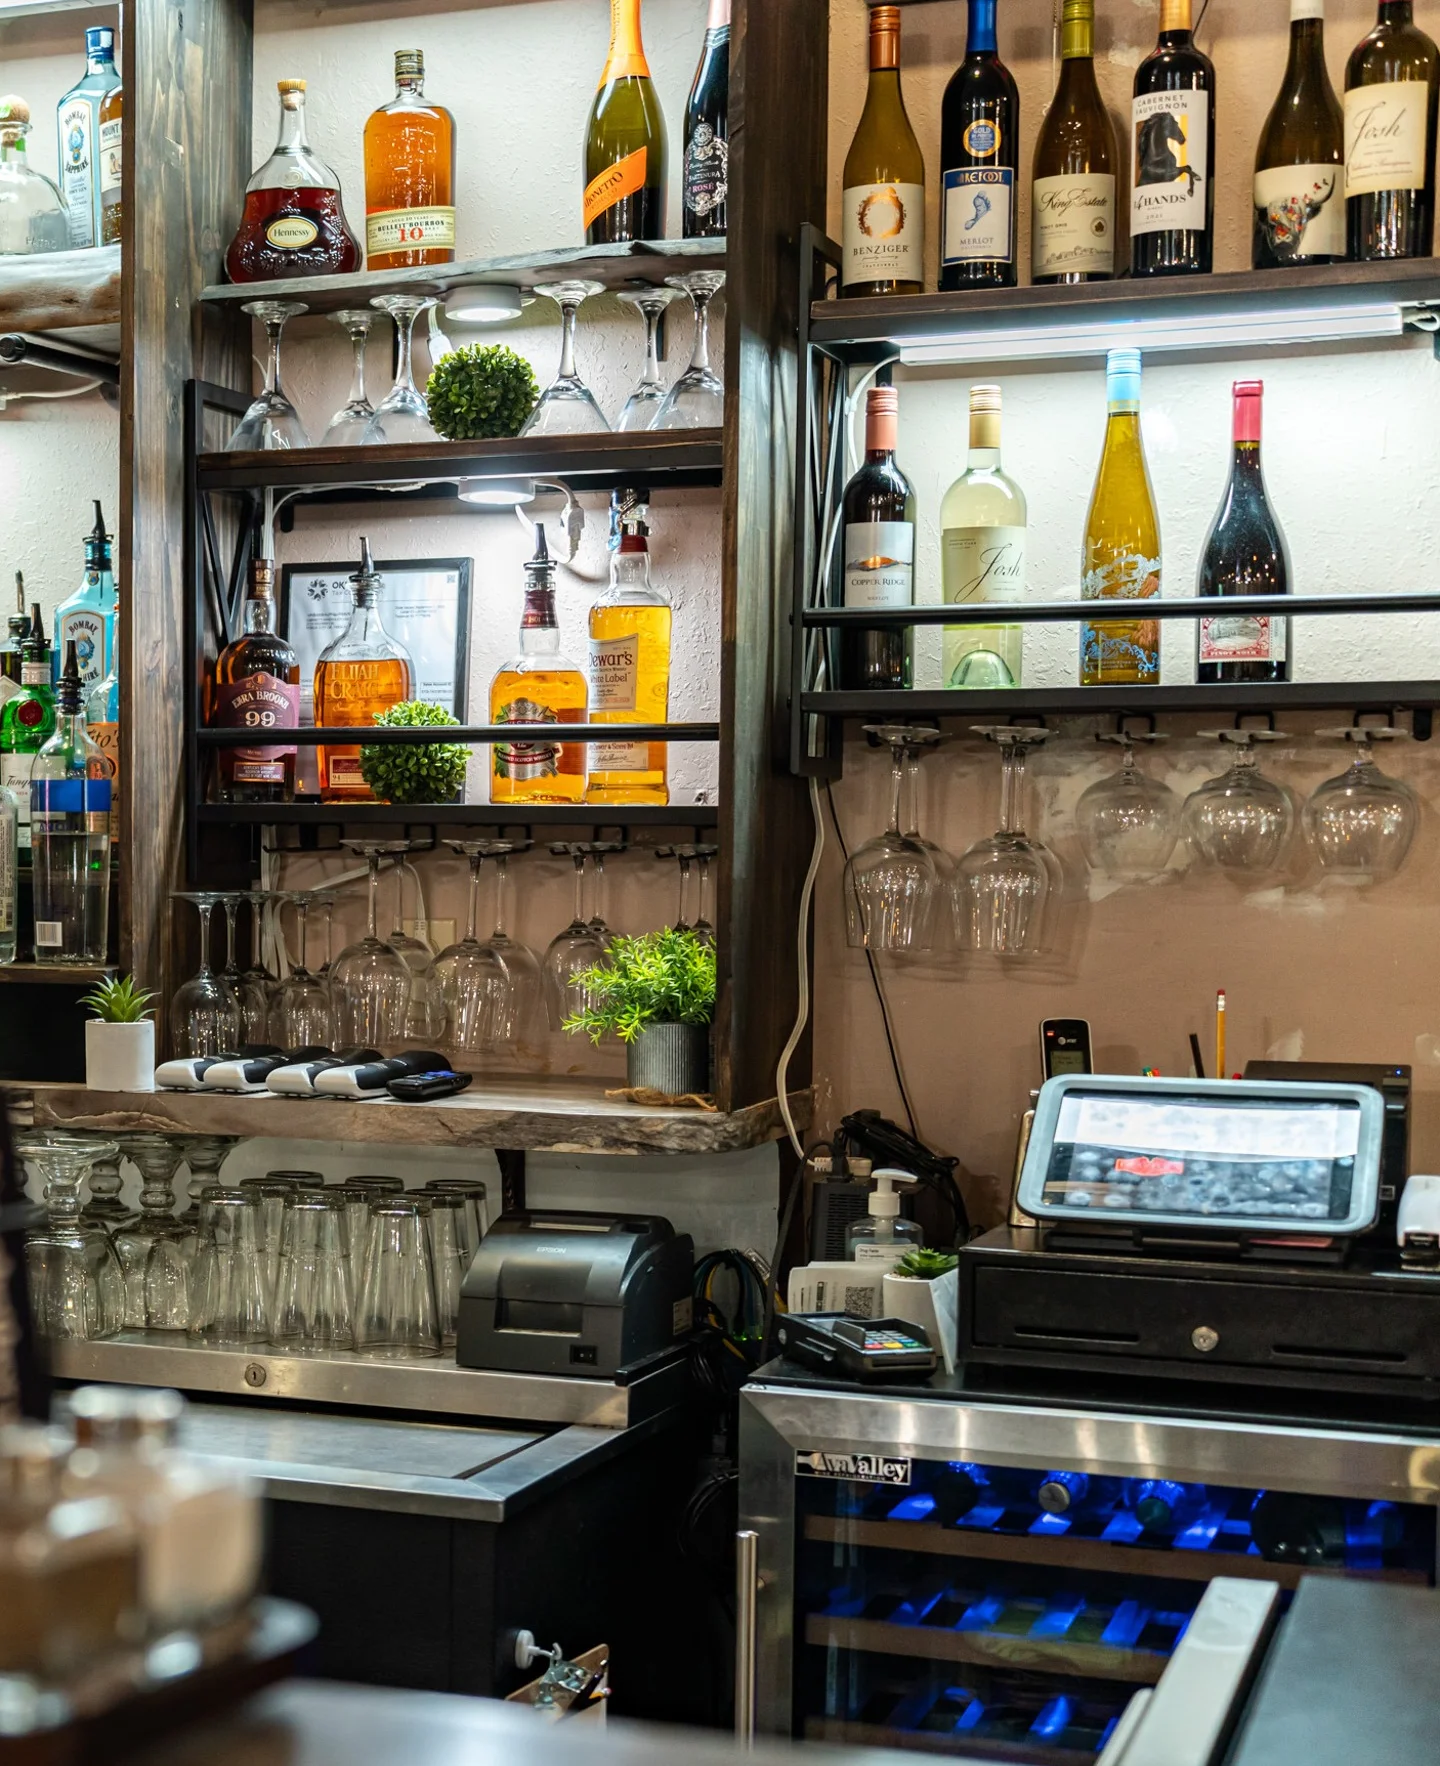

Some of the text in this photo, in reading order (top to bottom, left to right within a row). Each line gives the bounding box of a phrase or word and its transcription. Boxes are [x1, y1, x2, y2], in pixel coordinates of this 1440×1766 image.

[1137, 94, 1184, 108] CABERNET
[1135, 102, 1188, 116] SAUVIGNON
[1038, 187, 1108, 217] King Estate
[1143, 194, 1187, 207] HANDS
[273, 228, 310, 237] Hennessy
[377, 221, 445, 232] BULLEIT BOURBON
[398, 226, 423, 243] 10
[960, 237, 994, 245] MERLOT
[853, 244, 910, 256] BENZIGER
[882, 577, 906, 586] RIDGE
[68, 620, 99, 635] BOMBAY
[589, 651, 634, 668] Dewar's
[330, 664, 380, 682] ELIJAH
[605, 673, 627, 683] Label
[330, 681, 380, 700] CRAIG
[245, 711, 276, 727] 99
[536, 1246, 567, 1254] EPSON
